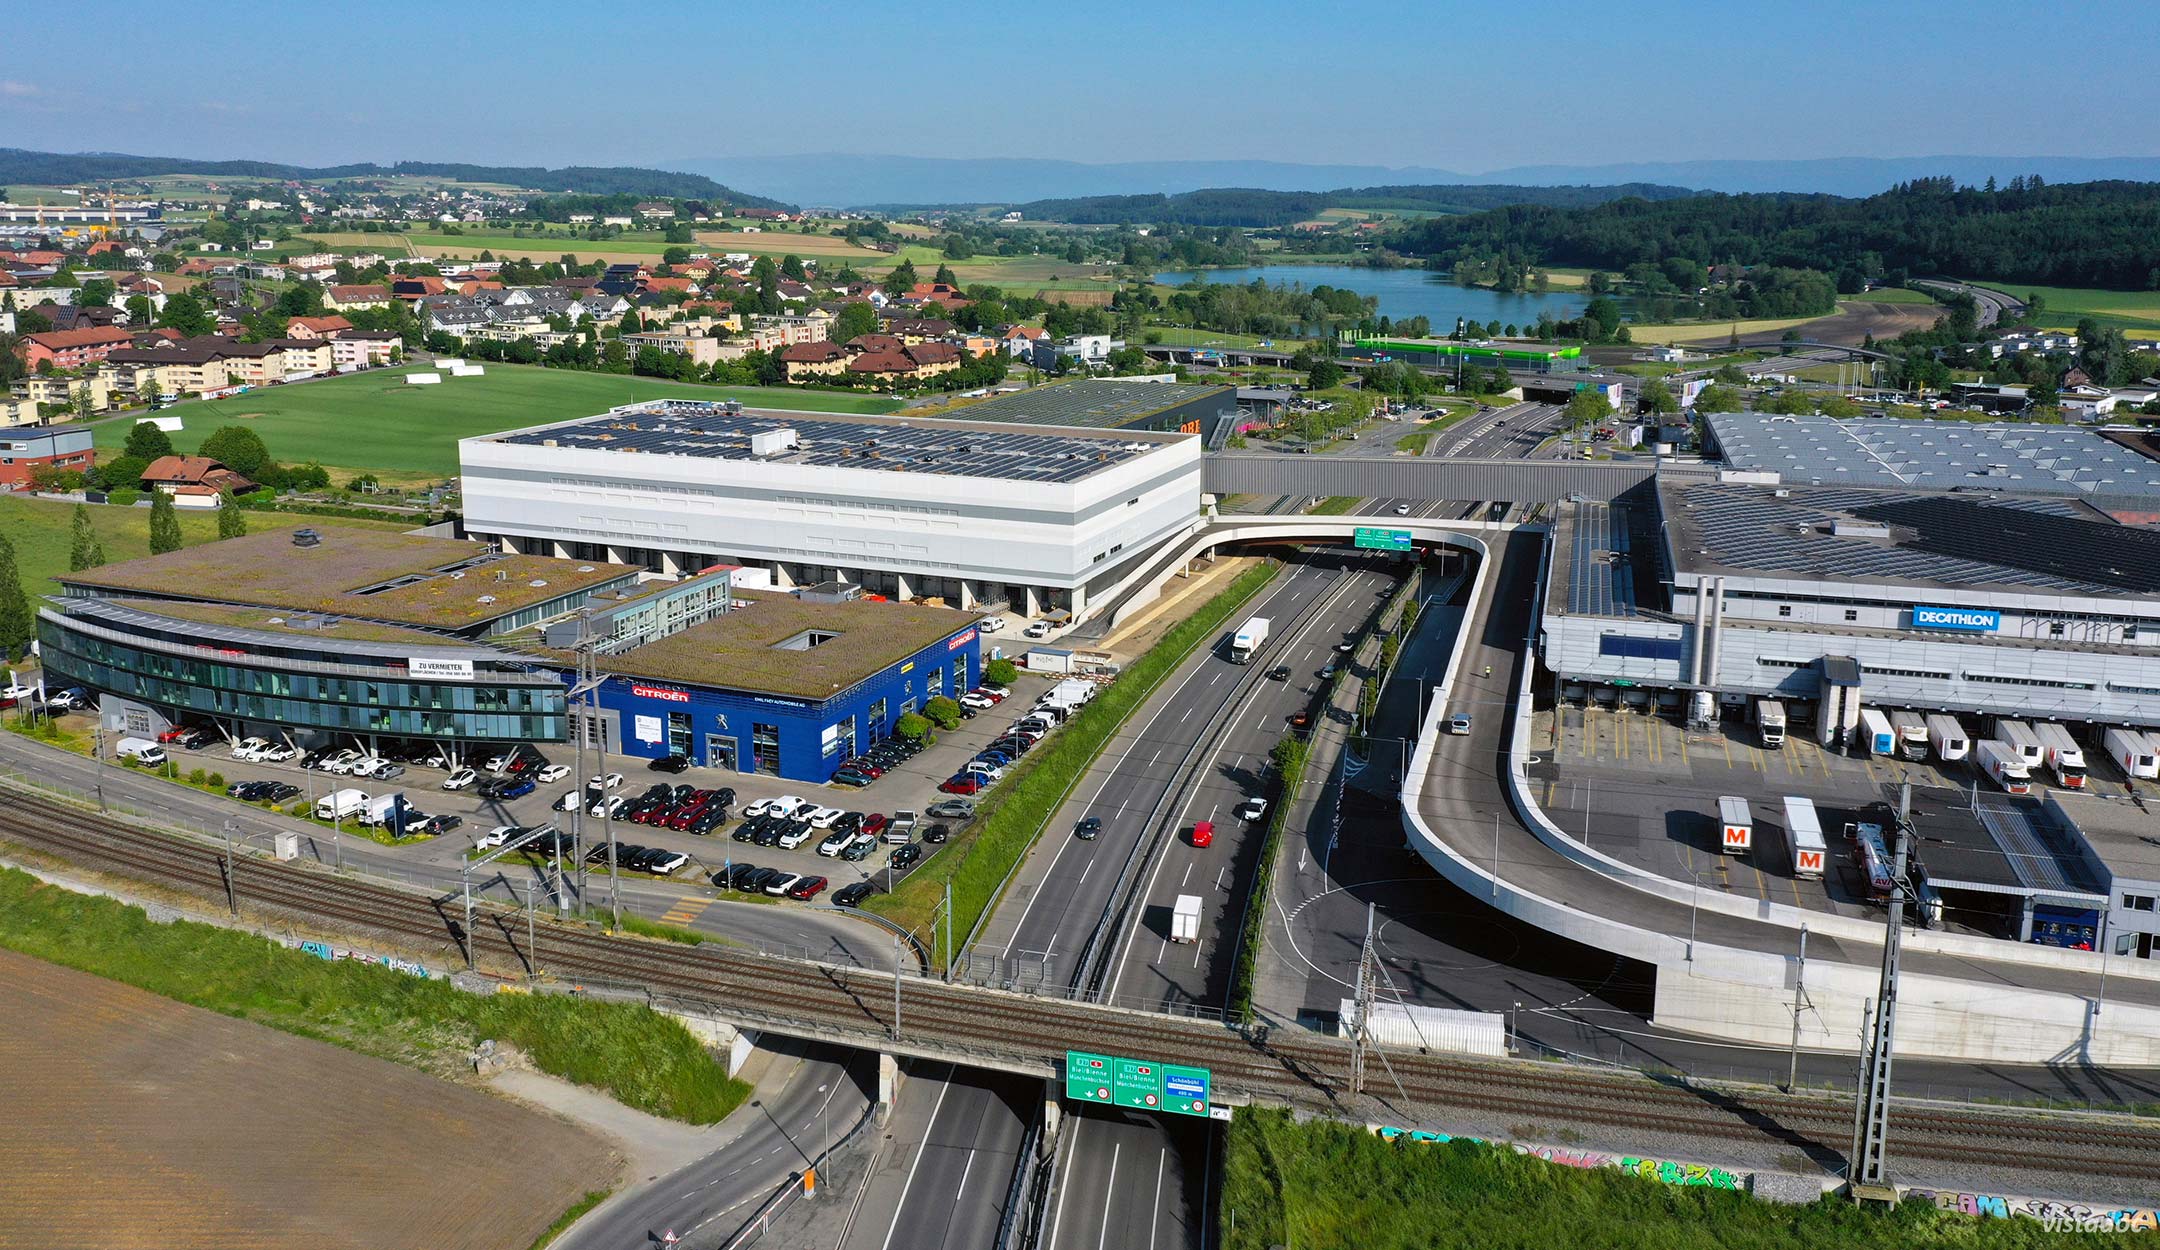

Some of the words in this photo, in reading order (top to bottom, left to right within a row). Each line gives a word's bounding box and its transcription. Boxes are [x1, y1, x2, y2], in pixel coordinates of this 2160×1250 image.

[1919, 611, 1994, 627] DECATHLON
[1726, 828, 1746, 845] M
[1799, 851, 1821, 869] M
[1071, 1066, 1107, 1077] Biel/Bienne
[1119, 1073, 1155, 1083] Biel/Bienne
